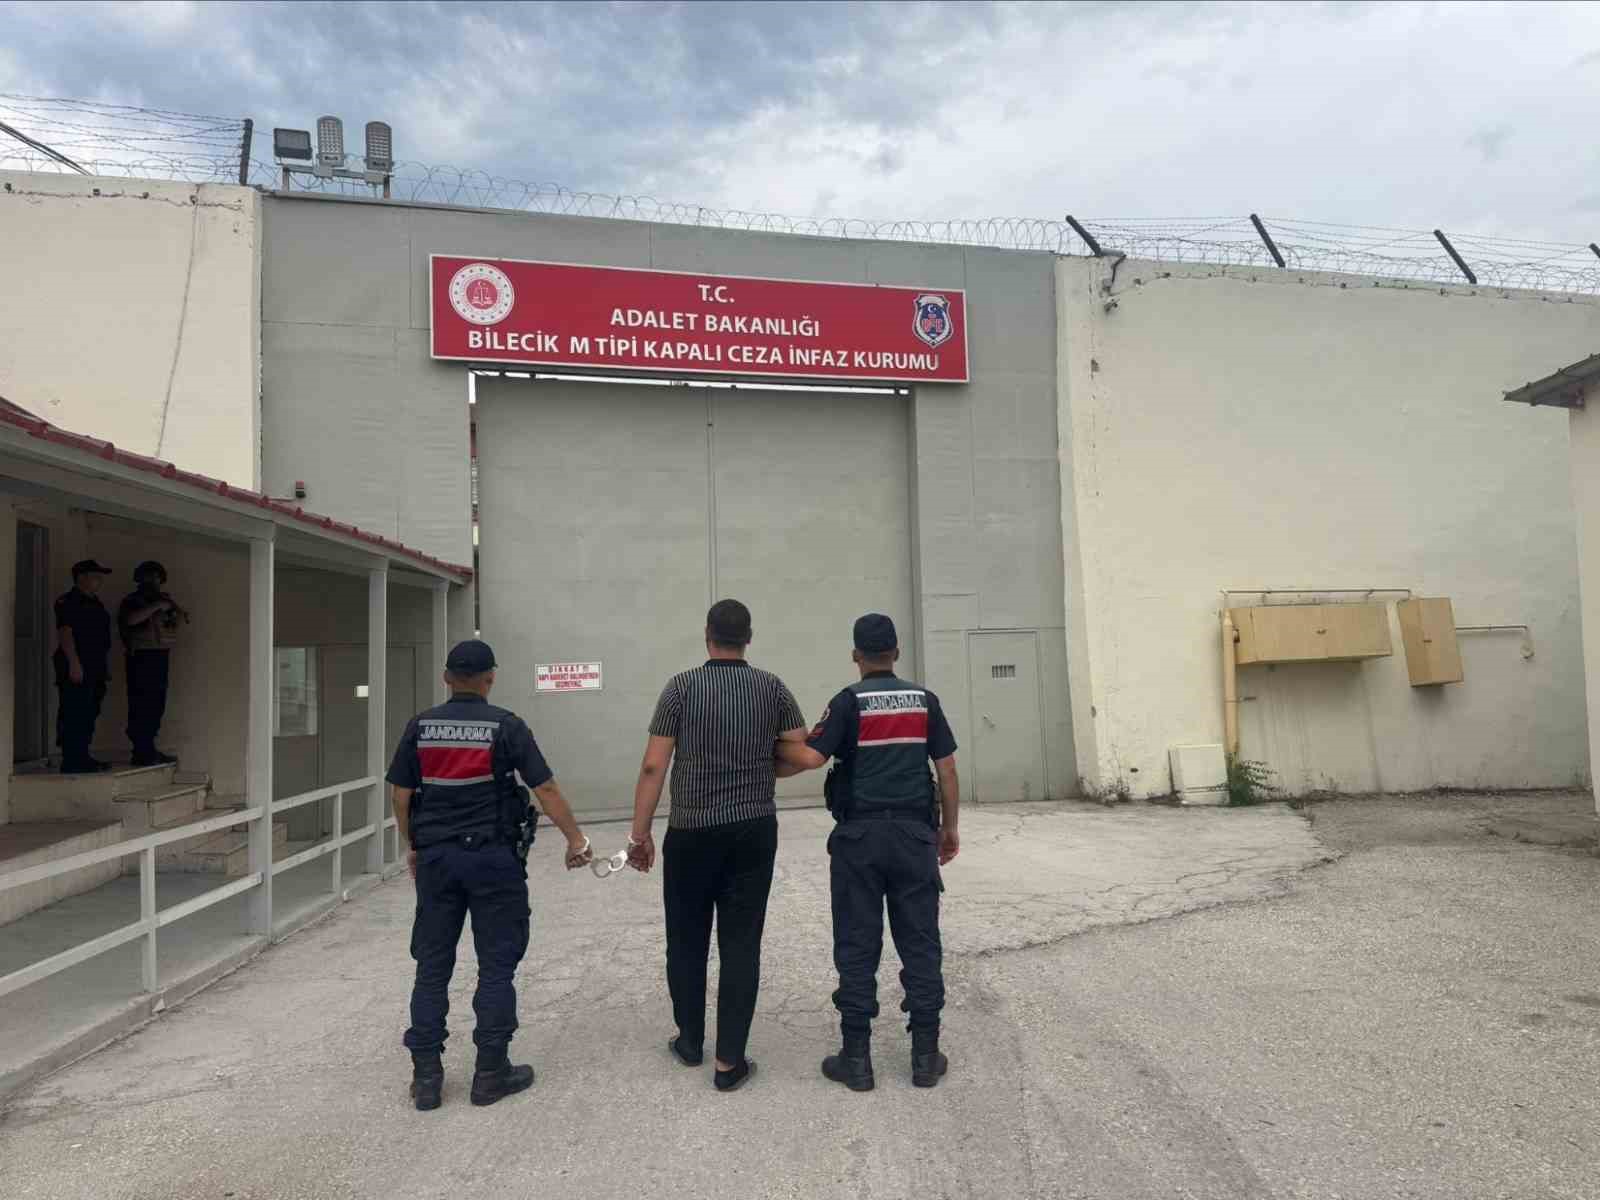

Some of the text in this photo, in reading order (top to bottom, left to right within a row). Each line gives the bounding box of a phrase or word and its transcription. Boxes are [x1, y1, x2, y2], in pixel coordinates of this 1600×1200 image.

[697, 284, 735, 303] T.C.
[610, 308, 820, 337] ADALET BAKANLIĞI
[468, 327, 939, 371] BİLECİK M TİPİ KAPALI CEZA İNFAZ KURUMU
[865, 694, 922, 711] JANDARMA
[420, 726, 493, 741] JANDARMA
